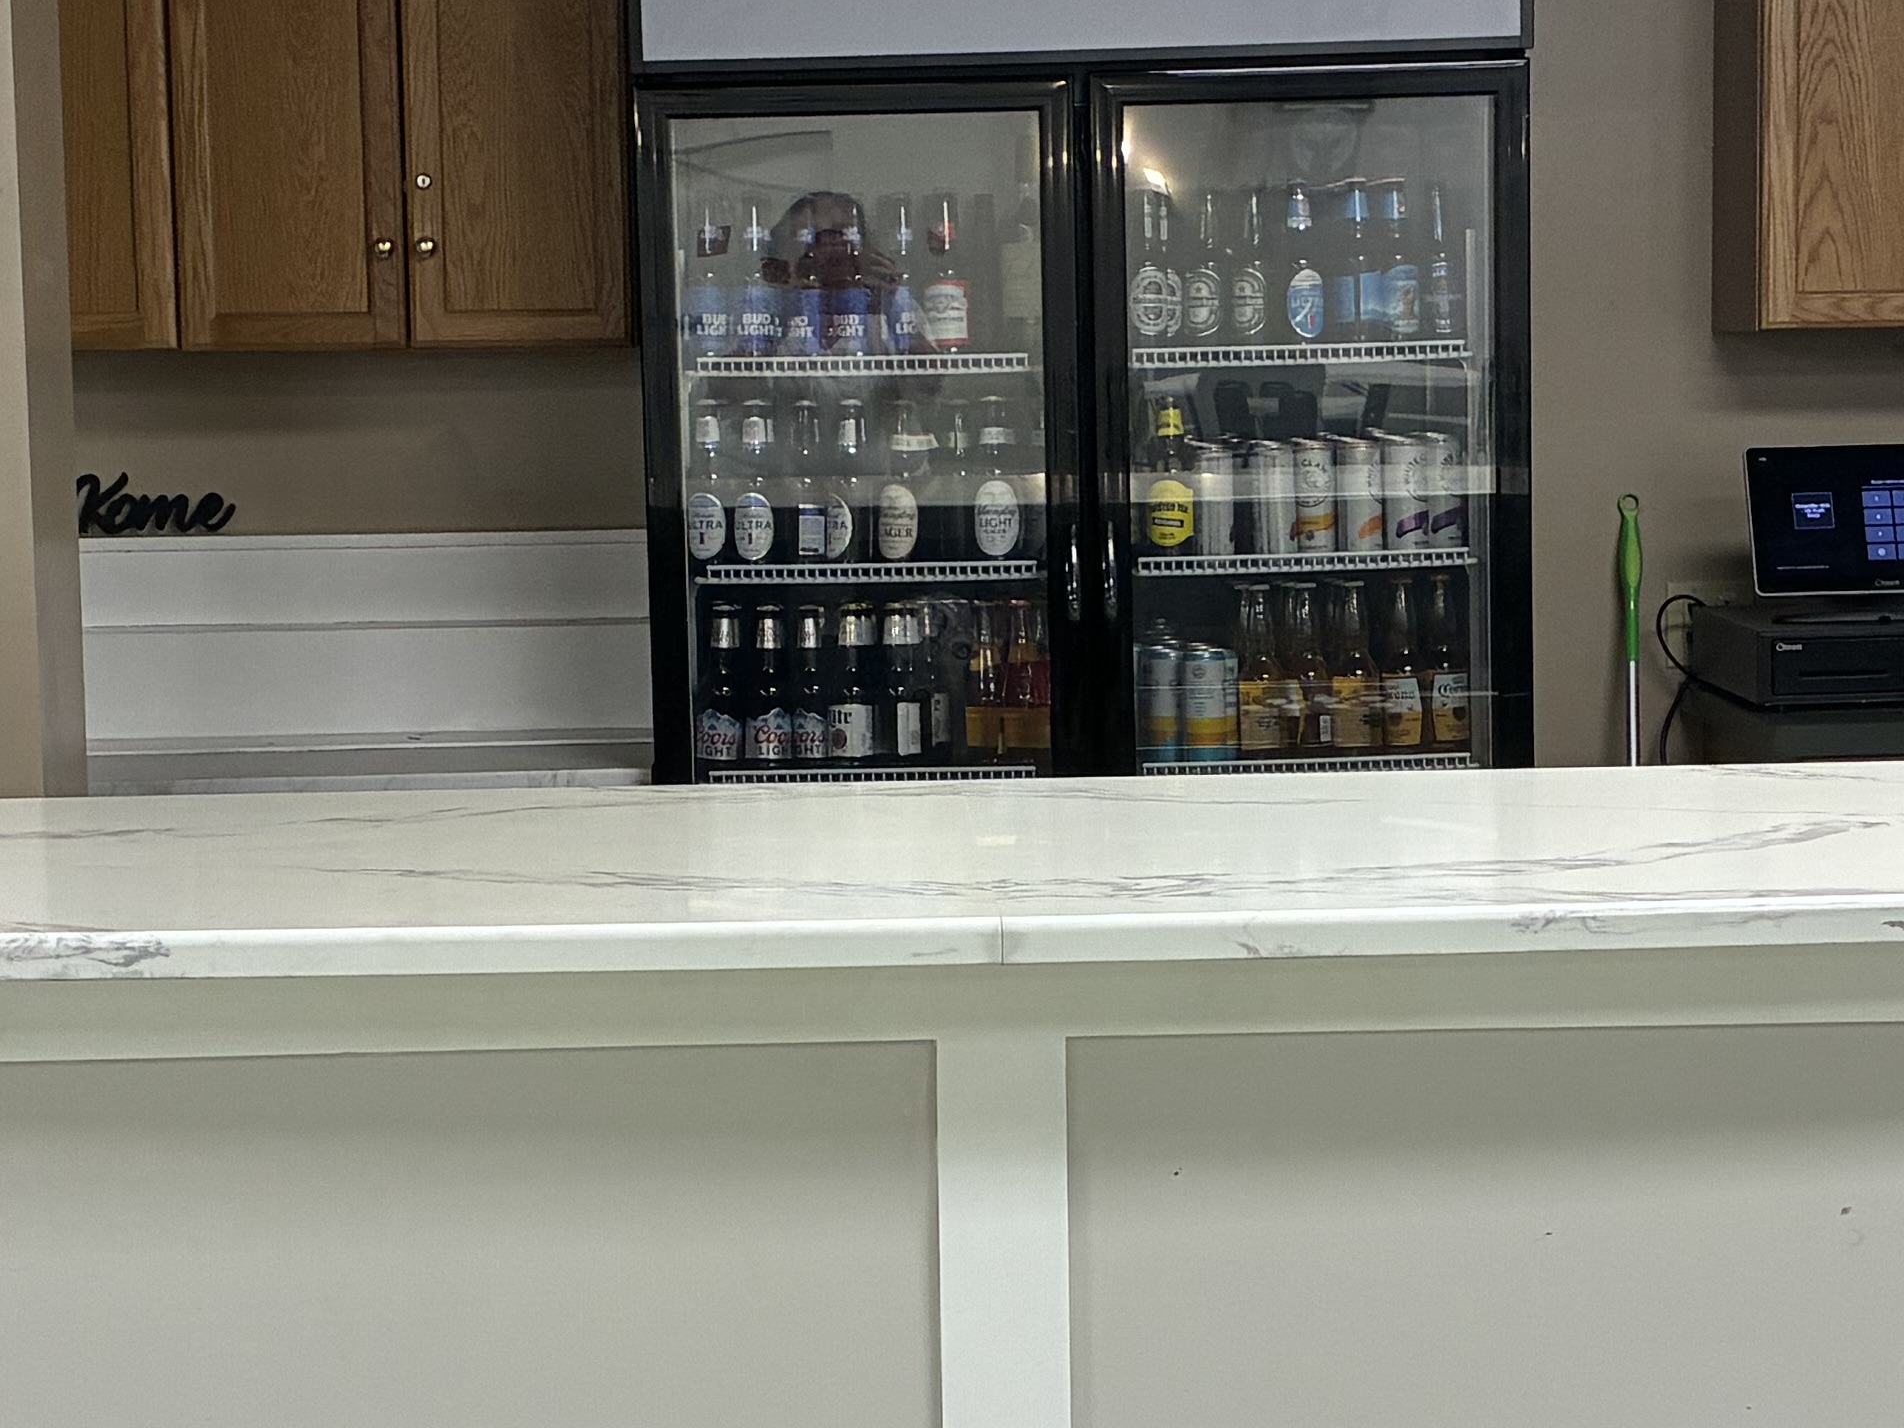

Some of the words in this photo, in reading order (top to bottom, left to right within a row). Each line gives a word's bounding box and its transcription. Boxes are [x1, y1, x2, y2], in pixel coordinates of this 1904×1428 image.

[742, 313, 771, 324] BUD
[737, 324, 774, 336] LIGHT
[979, 517, 1013, 528] LIGHT
[882, 528, 913, 538] AGER
[704, 746, 732, 757] GHT
